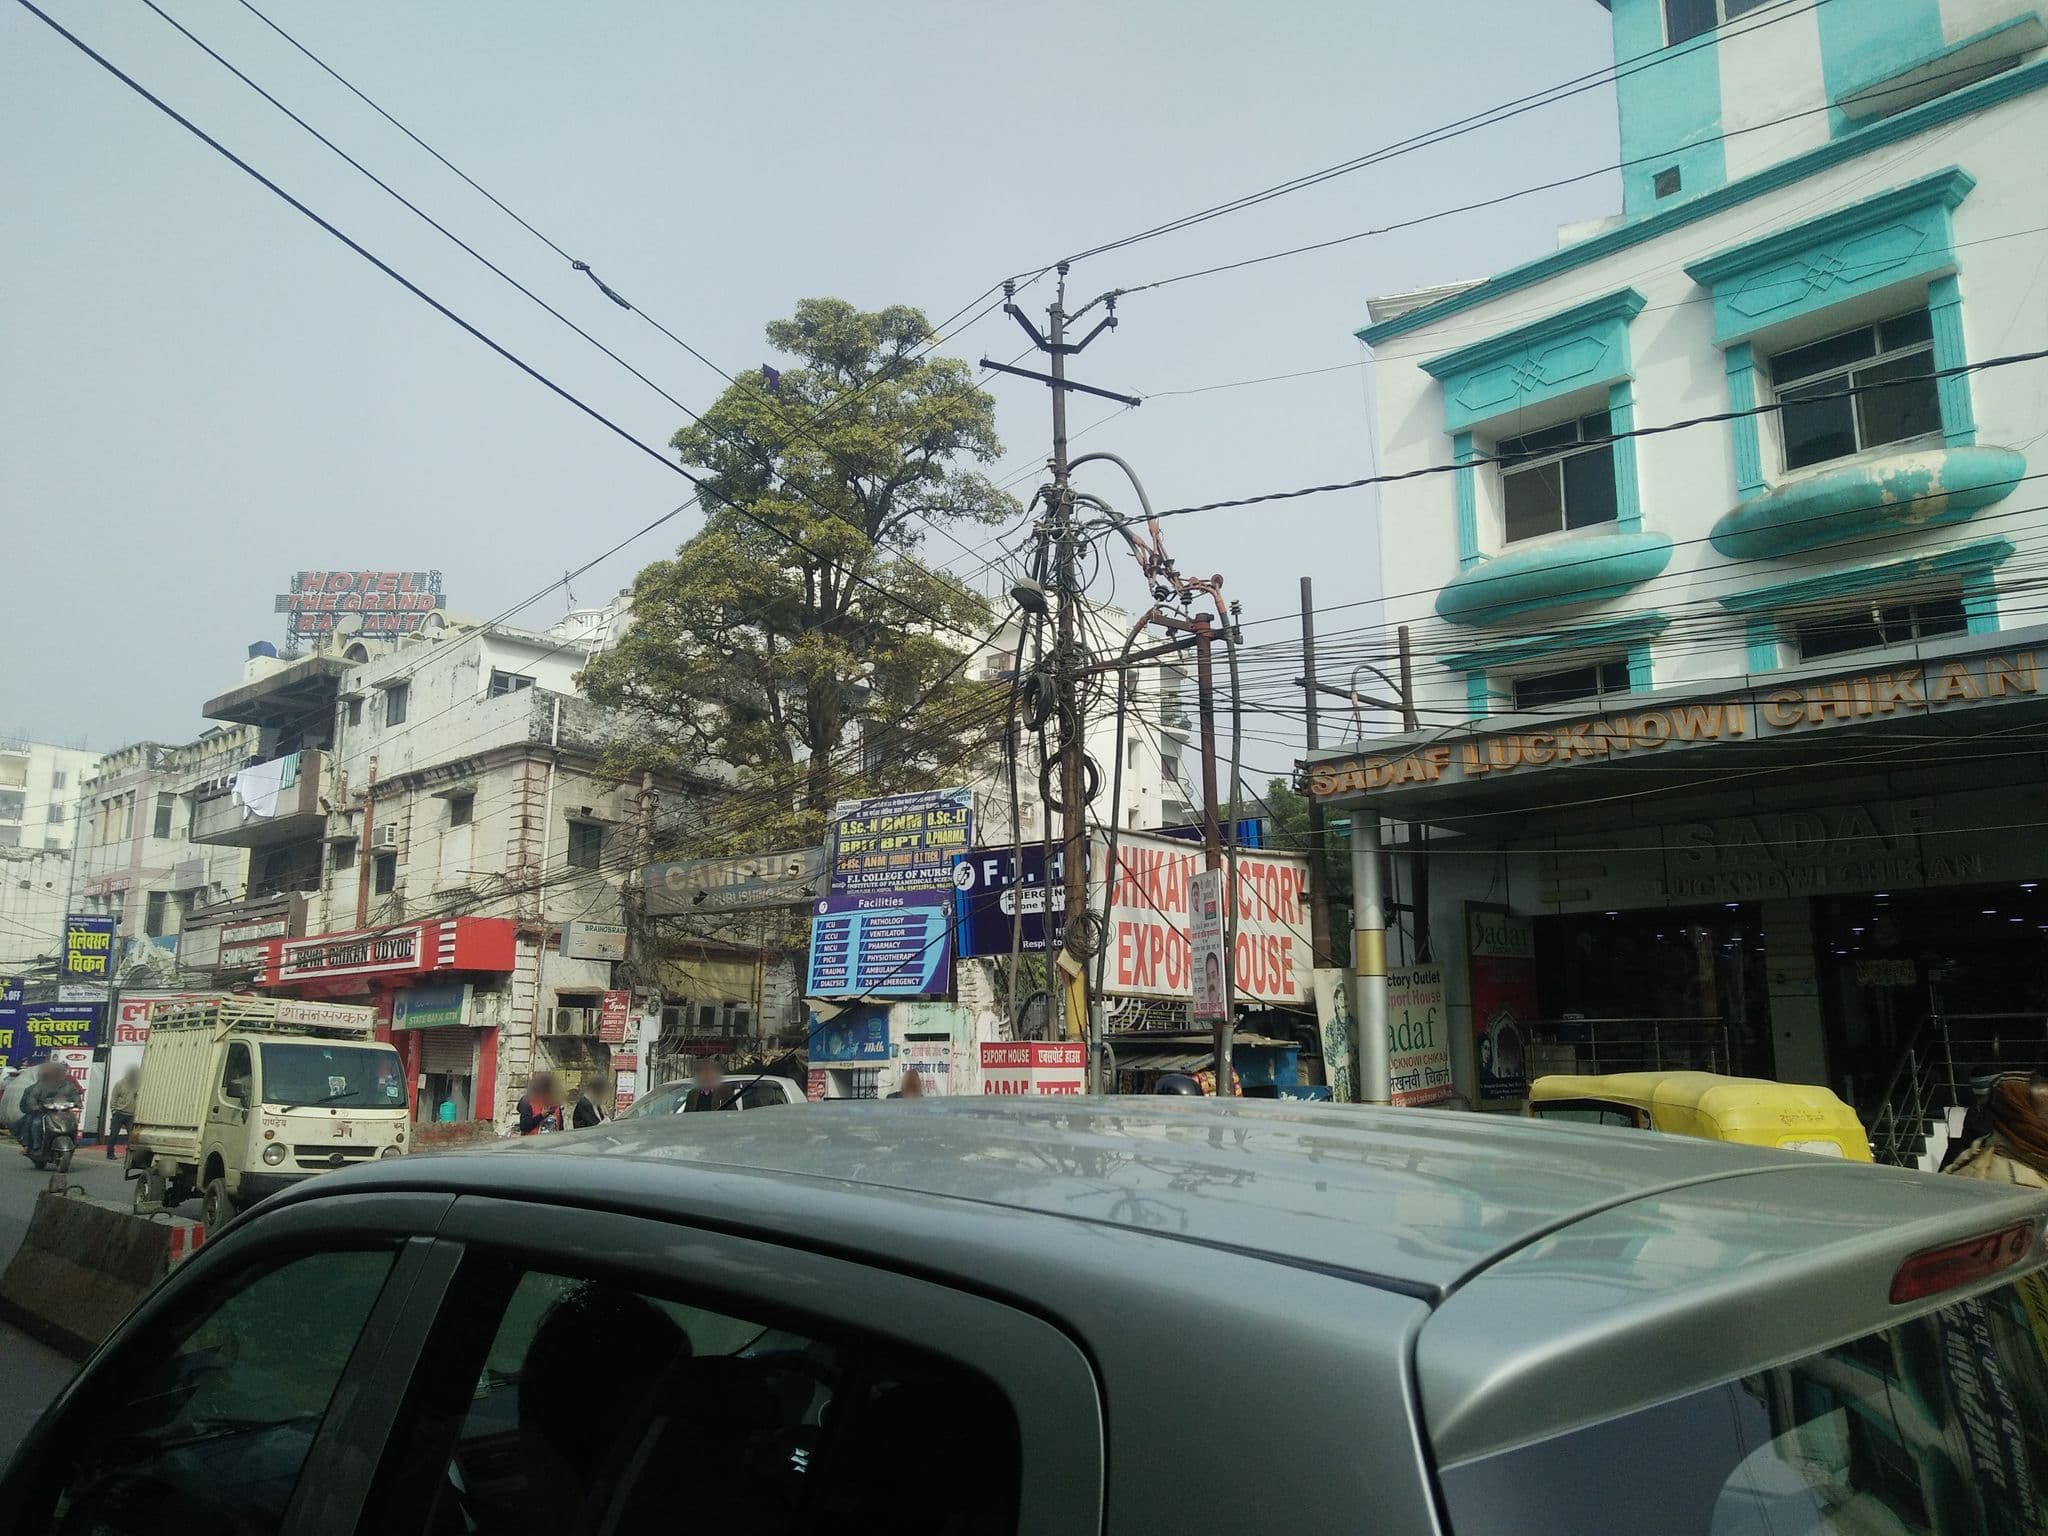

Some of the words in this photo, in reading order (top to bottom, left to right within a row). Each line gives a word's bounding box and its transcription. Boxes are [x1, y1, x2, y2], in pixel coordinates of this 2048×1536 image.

[304, 572, 418, 592] HOTEL
[289, 594, 337, 611] THE
[344, 594, 435, 611] GRAND
[298, 614, 419, 631] RAANT
[1311, 746, 1449, 796] SADAF
[1462, 699, 1744, 776] LUCKNOWI
[1763, 652, 2038, 728] CHIKAN
[881, 813, 922, 832] GNM
[1676, 797, 1935, 866] SADAF
[881, 835, 921, 850] BPT
[666, 853, 806, 891] CAMPUS
[862, 871, 905, 883] COLLEGE
[905, 870, 918, 879] OF
[920, 867, 953, 877] NURSI
[847, 881, 880, 889] INSTITUTE
[888, 879, 933, 887] PARAMEDICAL
[933, 876, 953, 884] SCIEN
[1220, 855, 1306, 926] CTORY
[858, 898, 904, 908] Facilities
[1008, 903, 1038, 911] Pone
[870, 917, 904, 926] PATHOLOGY
[869, 929, 905, 938] VENTILATOR
[374, 938, 412, 961] UDYOG
[867, 953, 916, 962] PHYSIOTHERAPY
[1118, 921, 1193, 990] EXPOR
[1234, 932, 1295, 995] OUSE
[883, 978, 920, 986] EMERGENCY
[1387, 973, 1411, 989] ctory
[1413, 970, 1440, 985] Outlet
[1390, 991, 1411, 1010] port
[1412, 989, 1441, 1005] House
[1388, 1007, 1437, 1052] adaf
[983, 1049, 1007, 1064] EXPORT
[1008, 1048, 1030, 1063] HOUSE
